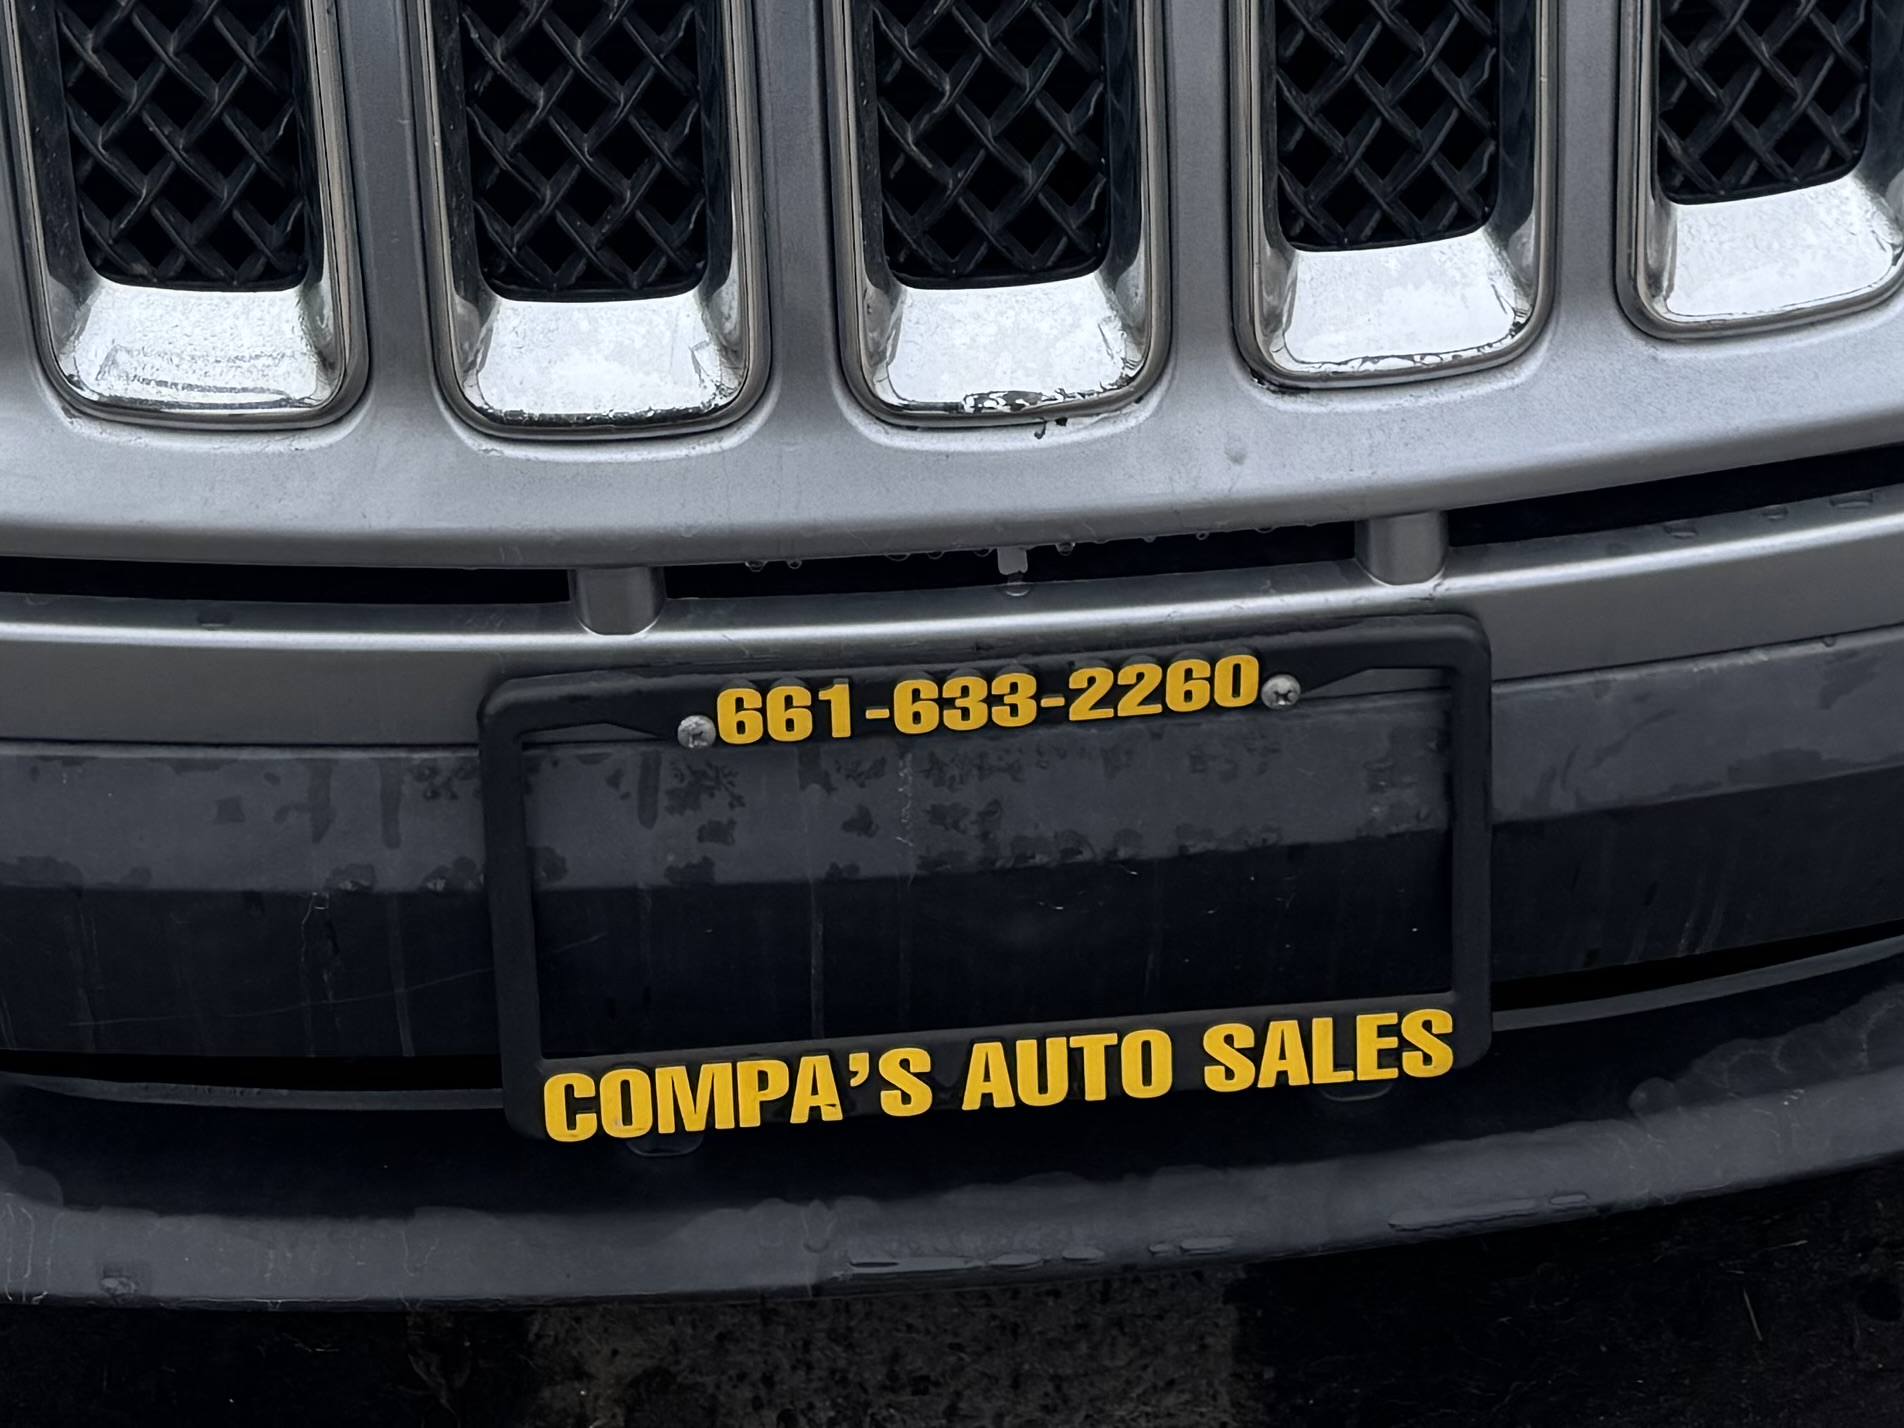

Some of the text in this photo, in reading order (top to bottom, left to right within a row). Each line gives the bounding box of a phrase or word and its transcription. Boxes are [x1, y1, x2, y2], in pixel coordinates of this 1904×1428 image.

[715, 654, 1261, 746] 661-633-2260
[542, 1007, 1455, 1144] COMPA'S AUTO SALES
